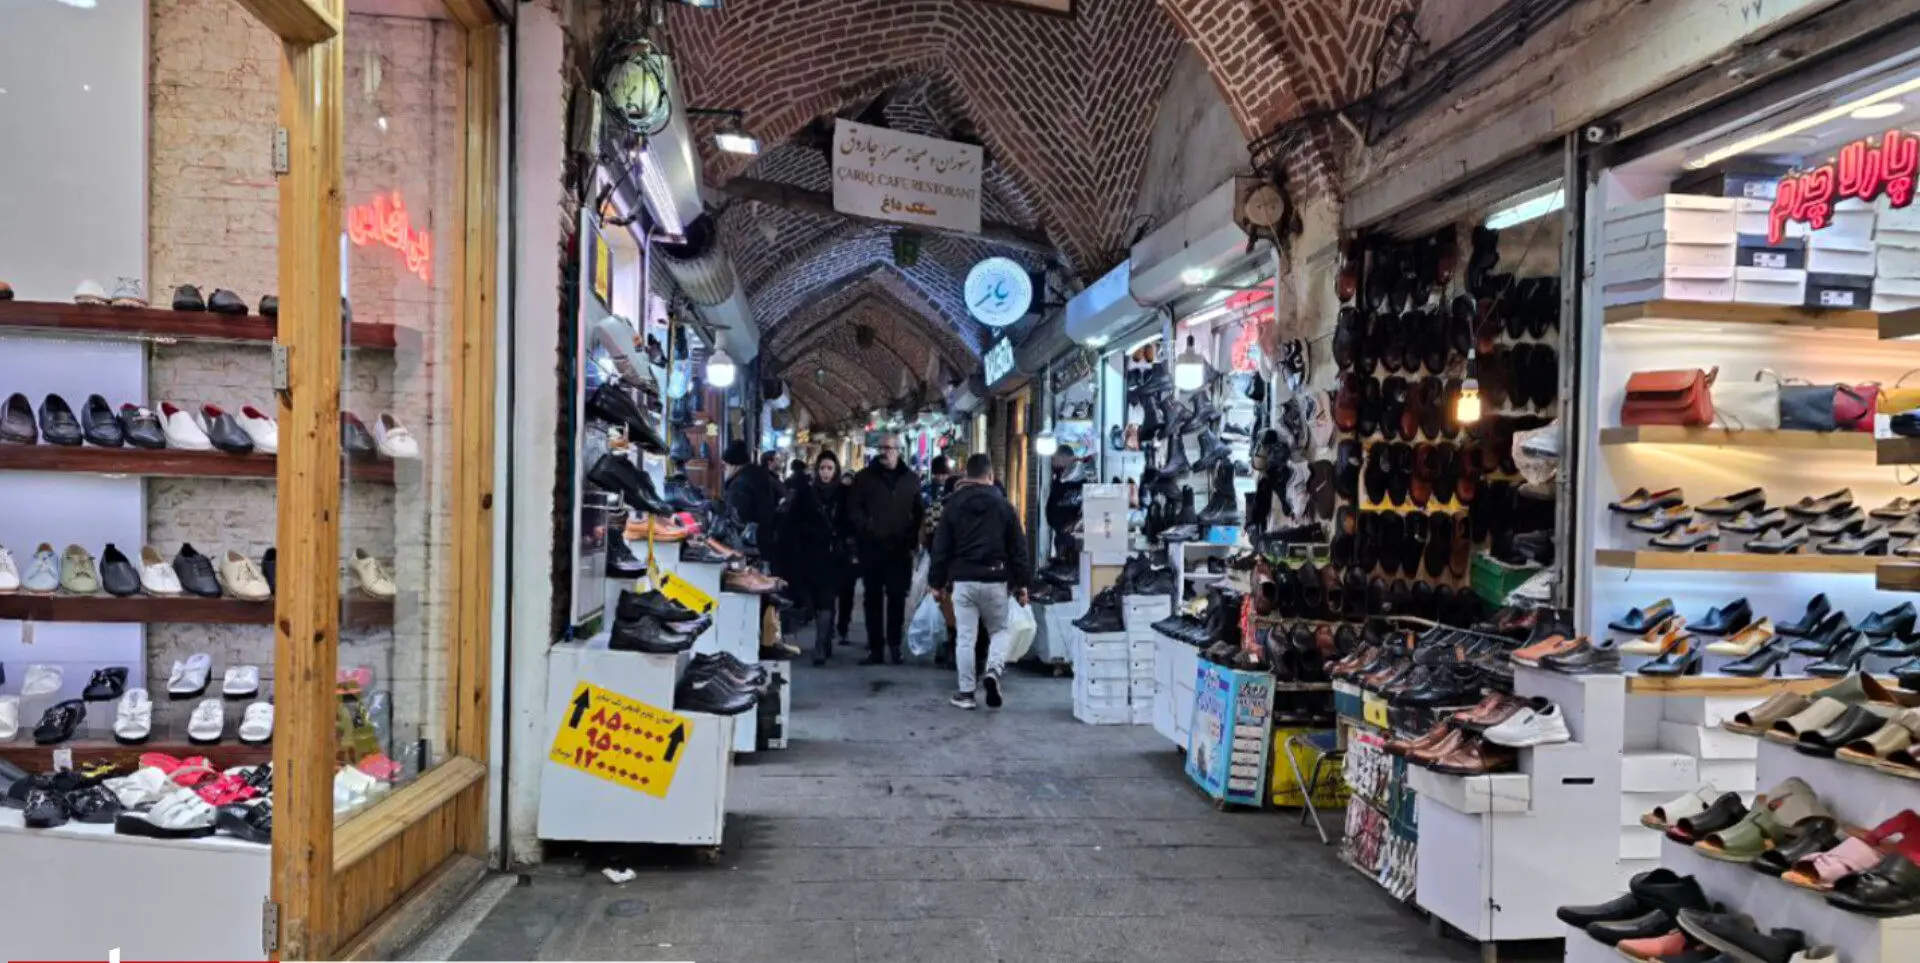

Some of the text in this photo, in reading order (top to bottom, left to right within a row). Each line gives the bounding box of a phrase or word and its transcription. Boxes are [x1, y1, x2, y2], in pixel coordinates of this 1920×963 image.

[880, 193, 902, 214] داغ
[1768, 164, 1834, 244] چرم
[590, 706, 664, 744] ۸۵۰۰۰۰
[587, 726, 655, 763] ۹۵۰۰۰۰
